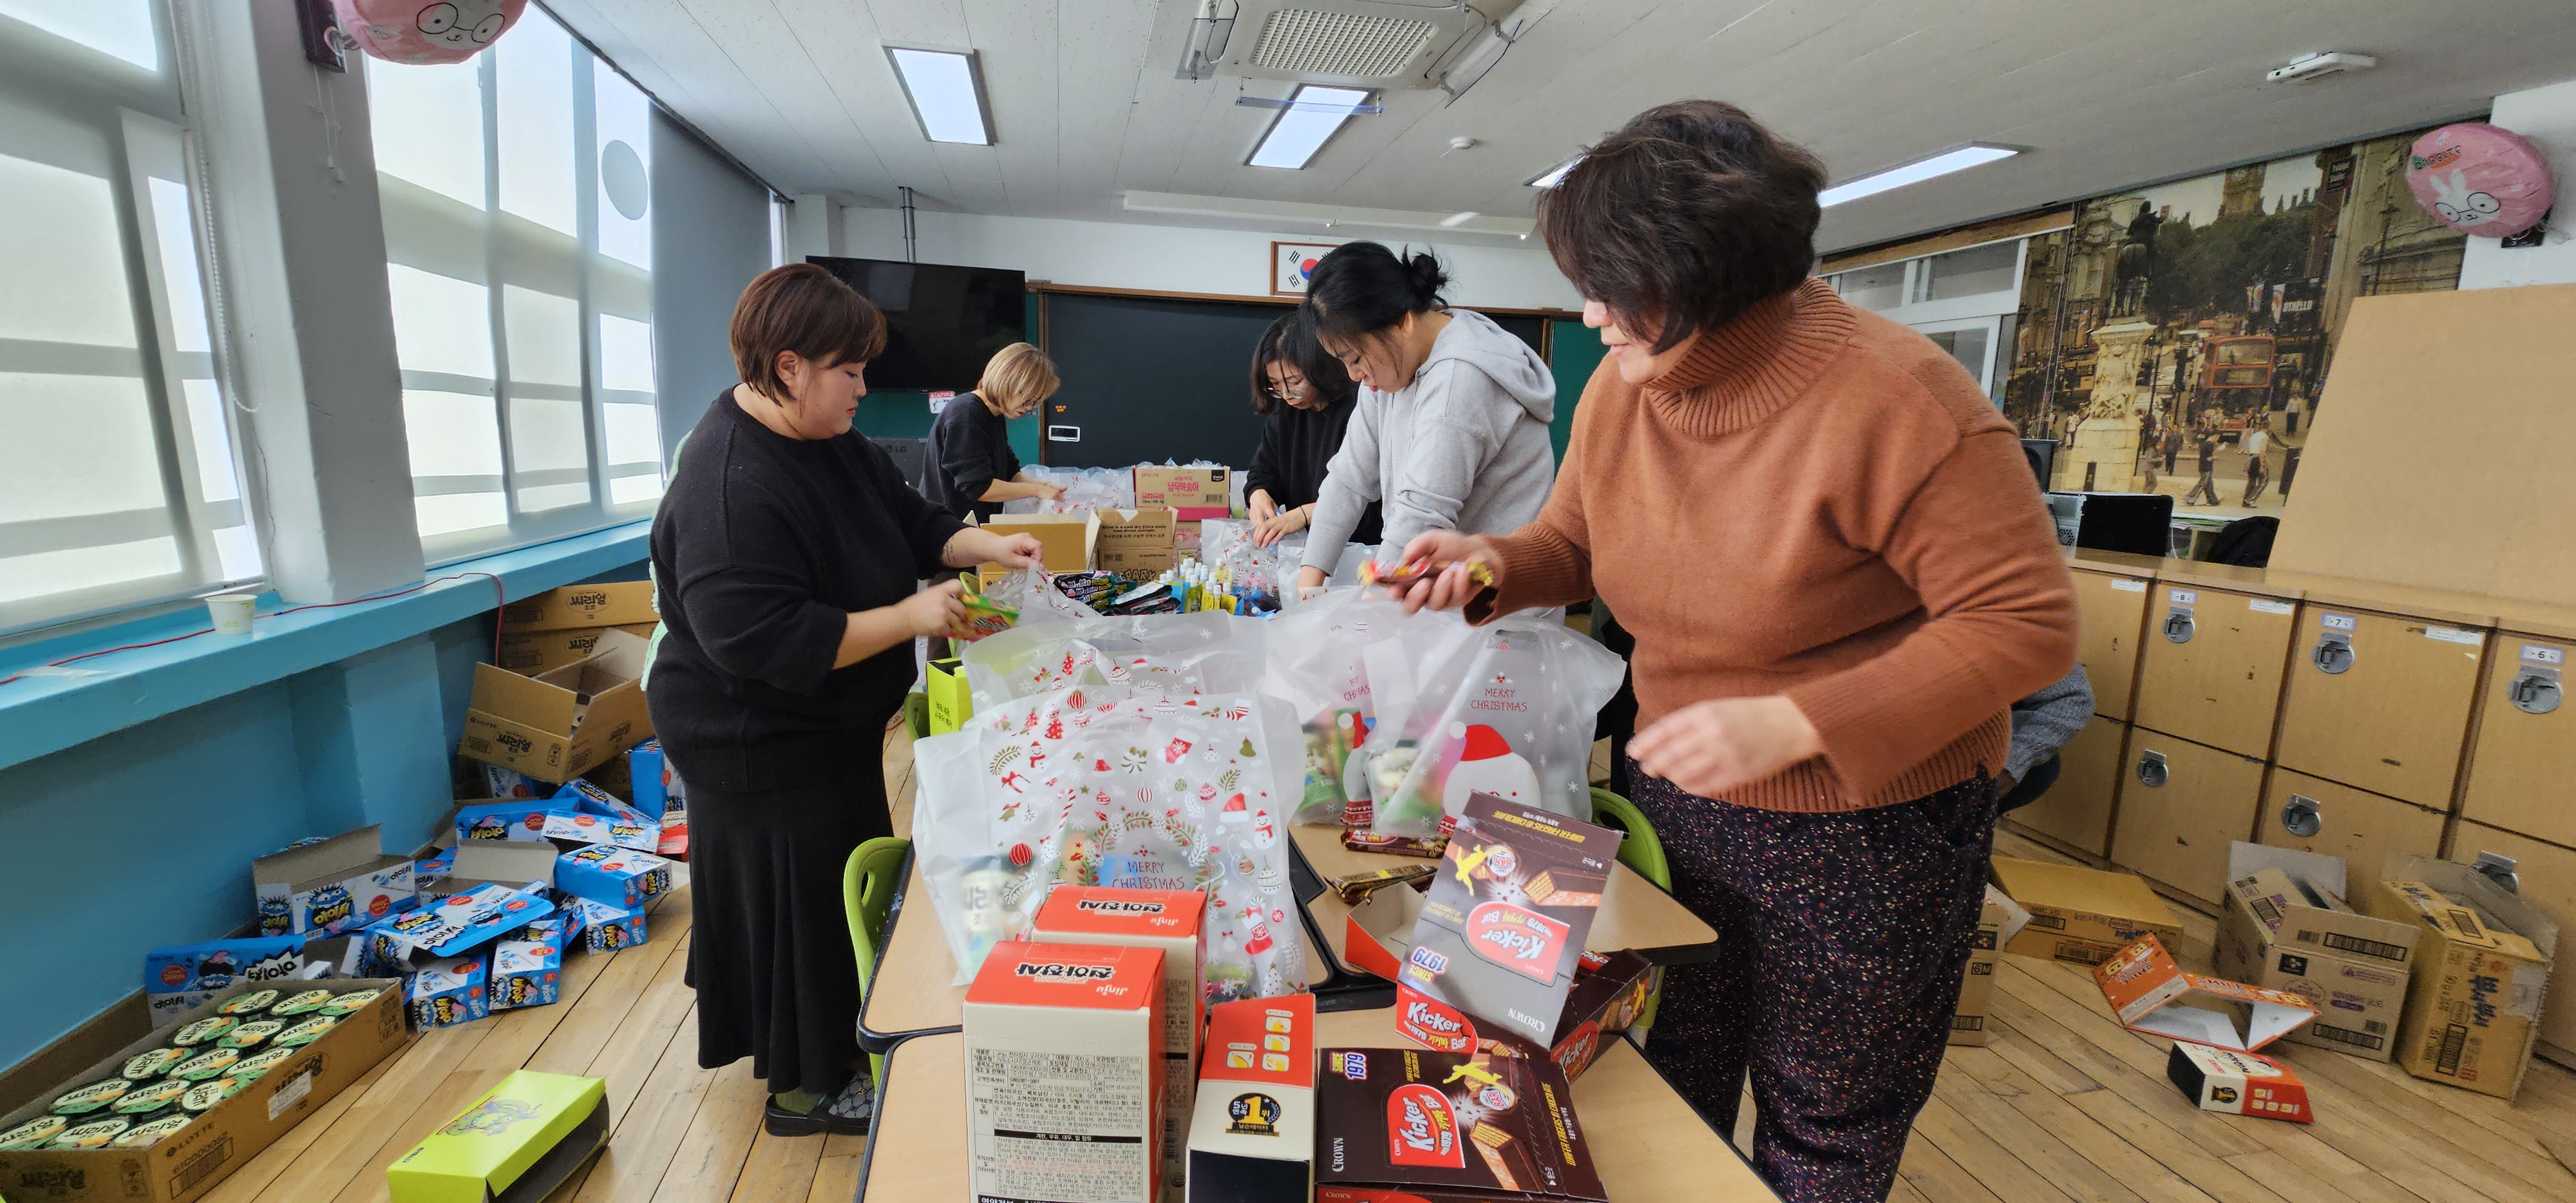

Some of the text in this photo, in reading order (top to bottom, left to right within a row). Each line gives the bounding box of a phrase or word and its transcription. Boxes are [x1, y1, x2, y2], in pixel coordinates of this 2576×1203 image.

[570, 593, 606, 605] 씨리얼
[568, 636, 599, 650] 씨리
[1485, 688, 1515, 697] MERRY
[1472, 700, 1528, 712] CHRISTMAS
[612, 827, 644, 835] 아이셔
[1559, 829, 1586, 844] WAFER
[1127, 861, 1164, 873] MERRY
[1493, 855, 1513, 868] BAR
[390, 865, 412, 880] 아이셔
[1112, 876, 1186, 890] CHRISTMAS
[314, 902, 350, 924] 아이셔
[1079, 900, 1165, 913] 천하장사
[1151, 917, 1179, 927] Jinju
[1481, 910, 1500, 926] Bar
[1527, 918, 1544, 934] 1979
[423, 925, 462, 946] 아이셔
[1481, 927, 1547, 960] Kicker
[1413, 947, 1449, 974] 1979
[247, 960, 297, 981] 아이셔
[1016, 963, 1115, 979] 천하장사
[1408, 963, 1434, 983] SINCE
[512, 978, 524, 1003] 아이셔
[1096, 985, 1128, 996] Jinju
[154, 996, 185, 1010] 아이셔
[436, 998, 452, 1023] 아이셔
[1407, 1001, 1463, 1033] Kicker
[1508, 1007, 1546, 1032] CROWN
[1450, 1036, 1468, 1050] Bar
[1332, 1053, 1345, 1073] SINCE
[1347, 1053, 1367, 1080] 1979
[65, 1082, 122, 1101] 씨리얼
[126, 1083, 180, 1101] 씨리얼
[1490, 1092, 1504, 1108] BAR
[1540, 1081, 1558, 1112] CHOCOLATE
[1419, 1094, 1441, 1110] Bar
[123, 1117, 184, 1139] 씨리얼
[1399, 1097, 1435, 1151] Kicker
[1553, 1119, 1570, 1143] FINGERS
[175, 1122, 214, 1150] LOTTE
[1439, 1131, 1453, 1148] 1979
[1332, 1137, 1344, 1172] CROWN
[1561, 1142, 1577, 1166] WAFER
